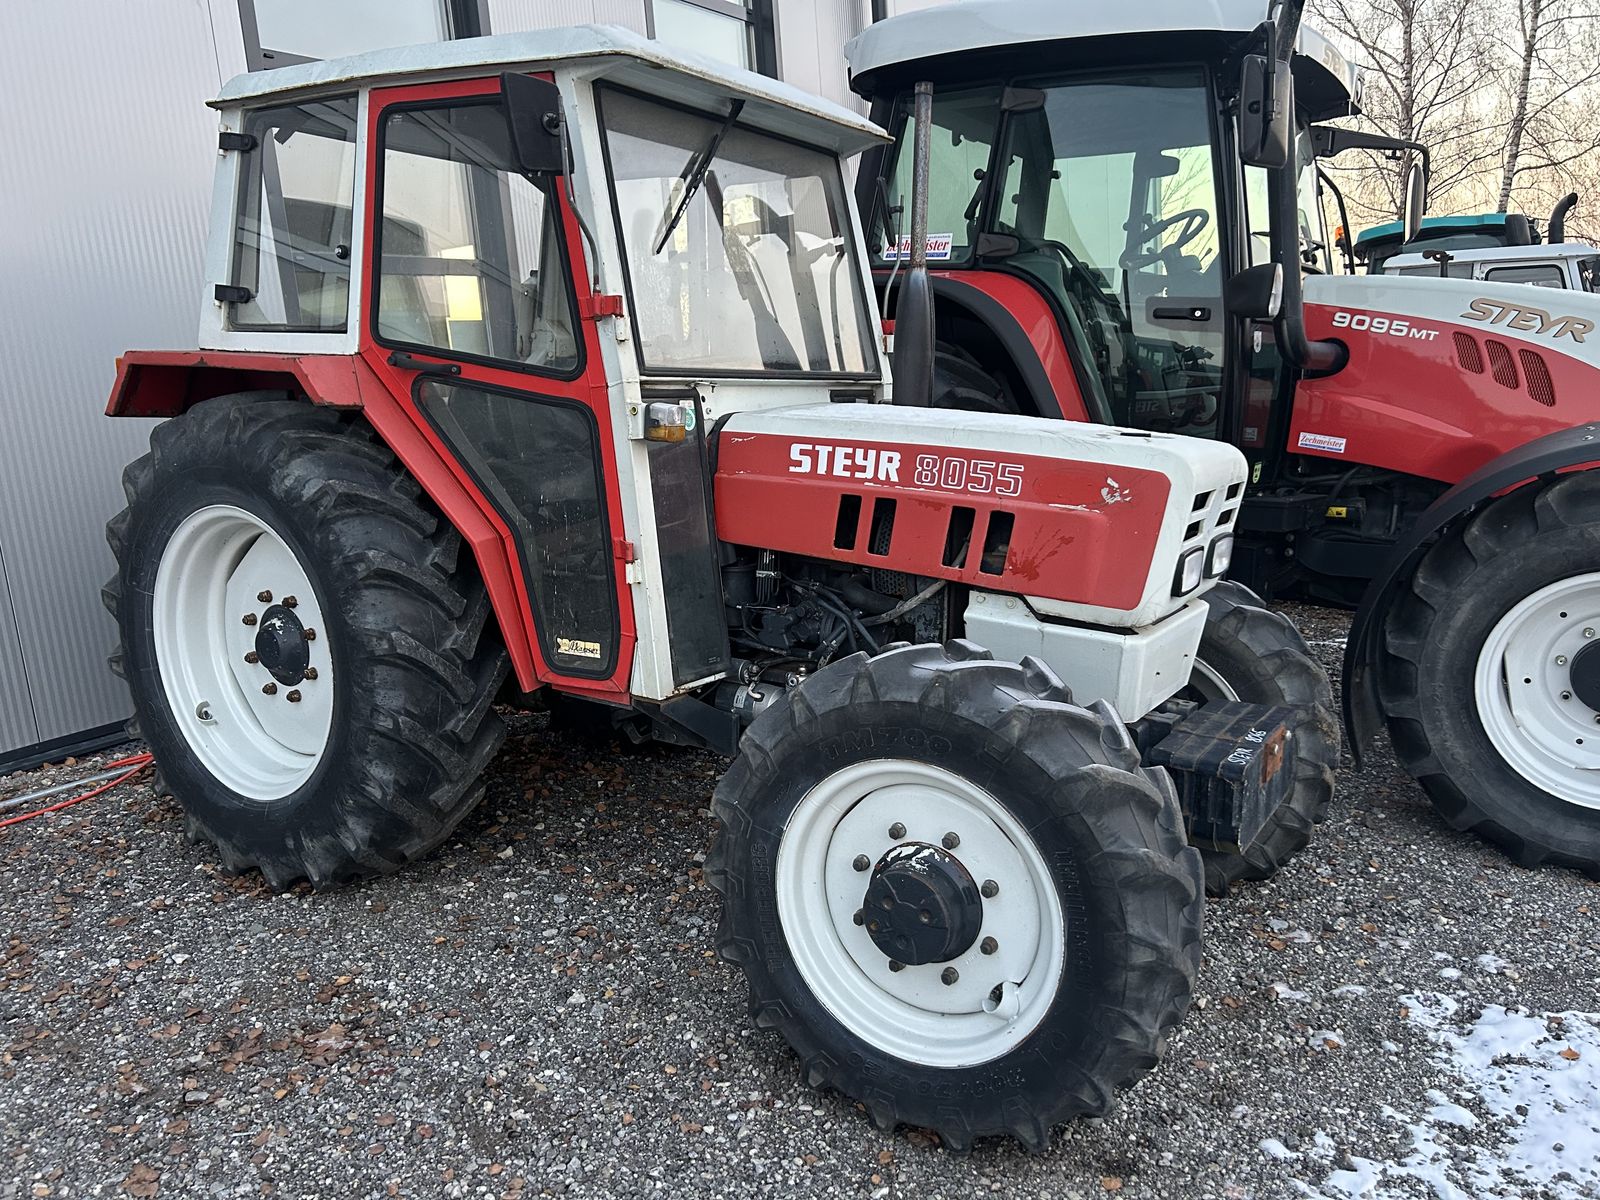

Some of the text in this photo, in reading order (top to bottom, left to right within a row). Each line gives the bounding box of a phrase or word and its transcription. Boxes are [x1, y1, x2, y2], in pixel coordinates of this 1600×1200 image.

[1460, 298, 1594, 343] STEYR
[1300, 434, 1344, 448] Zechmeister
[788, 443, 1025, 497] STEYR 8055
